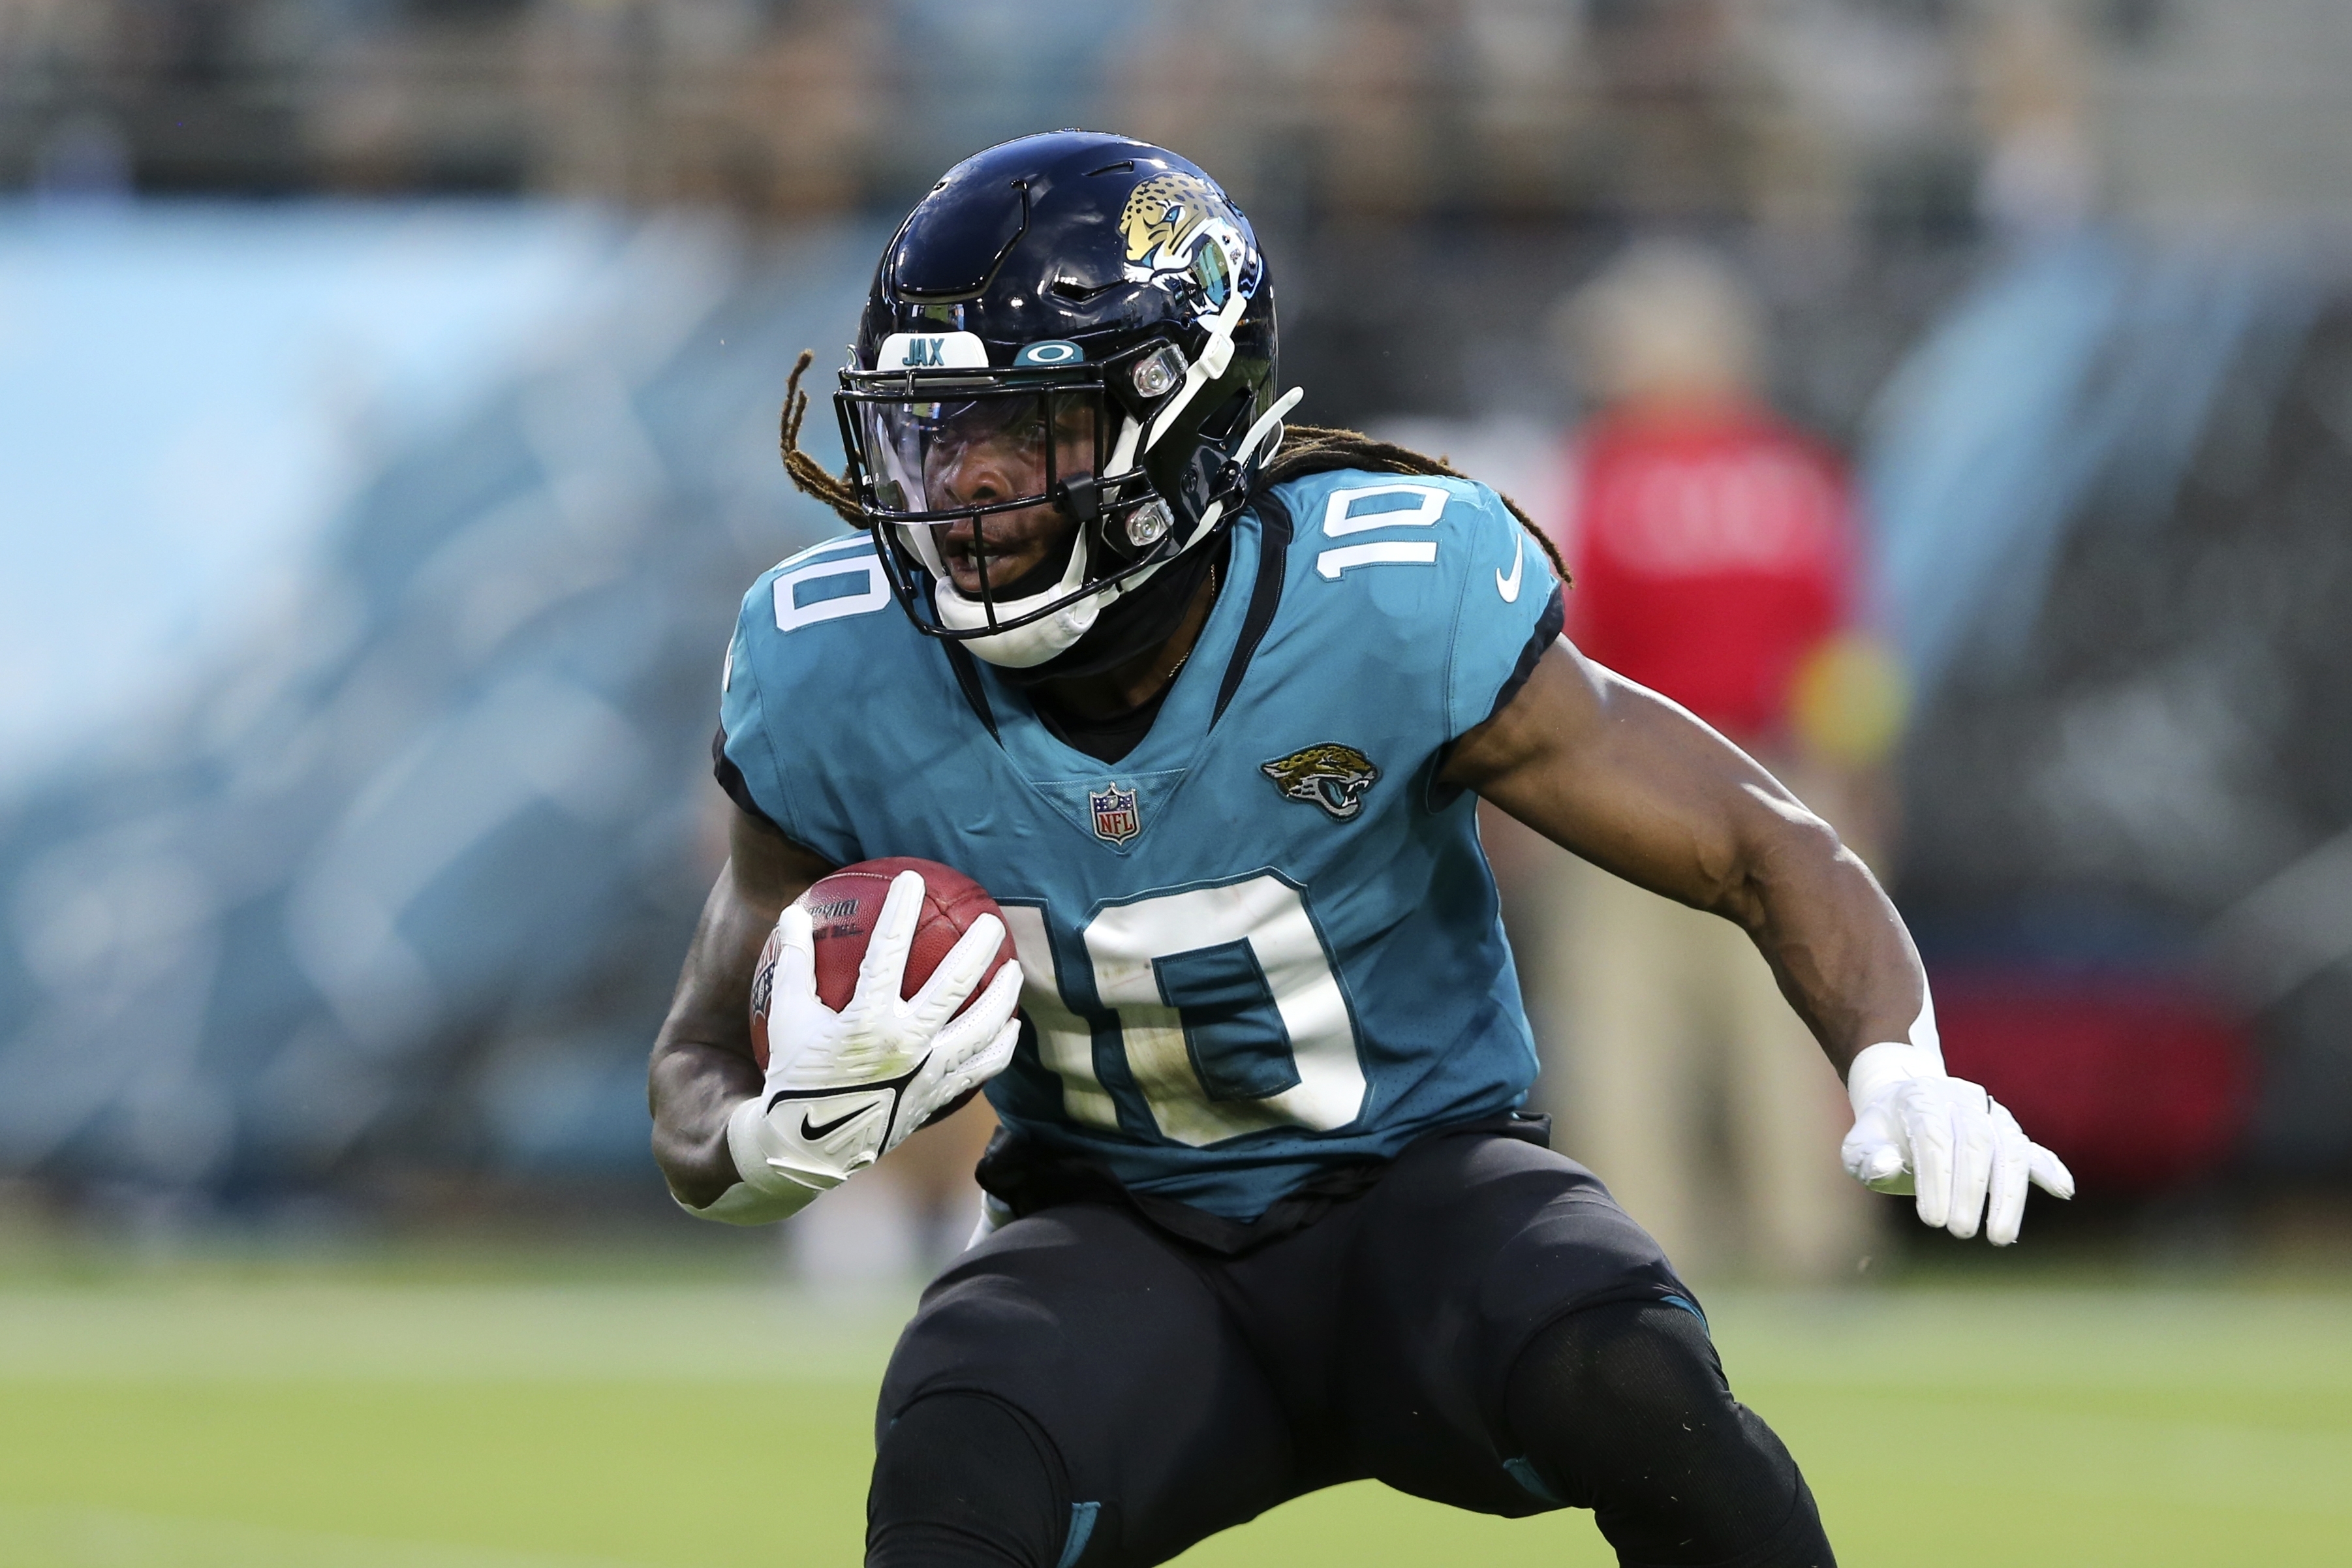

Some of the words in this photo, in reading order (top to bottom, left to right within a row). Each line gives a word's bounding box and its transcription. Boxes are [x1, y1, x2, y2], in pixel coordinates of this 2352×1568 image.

[902, 338, 946, 367] JAX
[1316, 483, 1451, 580] 10
[1098, 812, 1134, 835] NFL
[997, 874, 1369, 1148] 10
